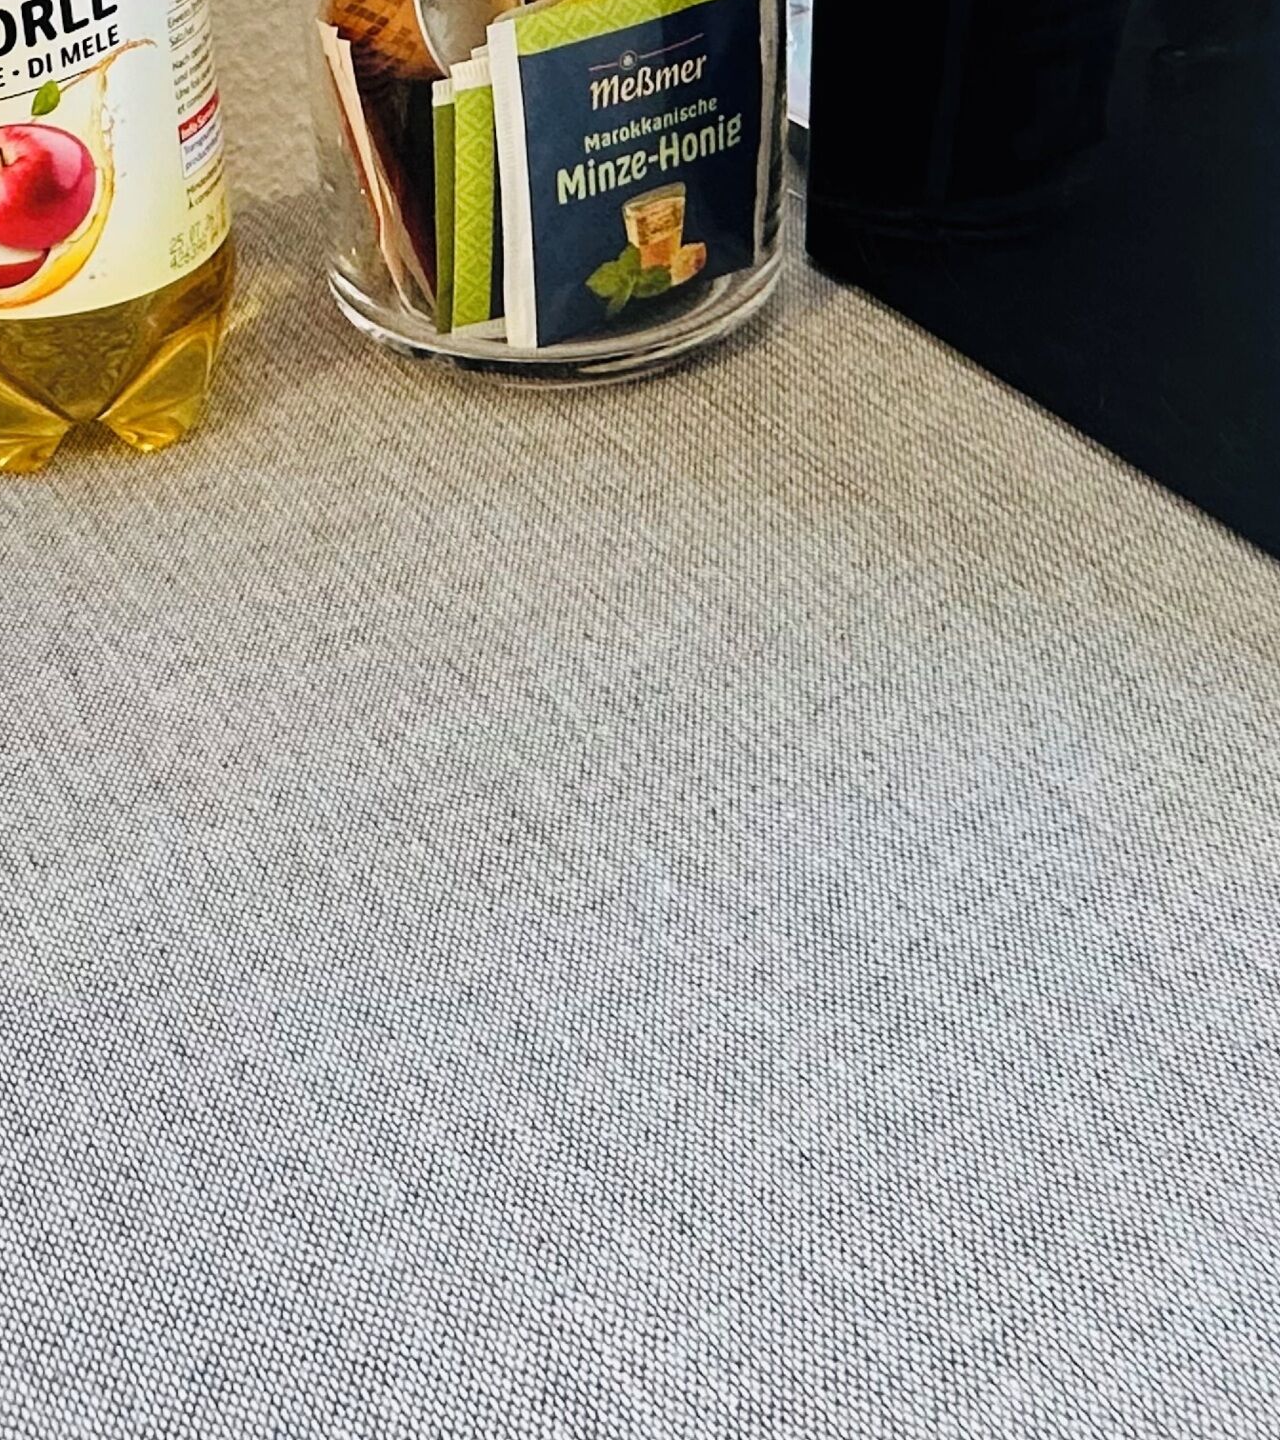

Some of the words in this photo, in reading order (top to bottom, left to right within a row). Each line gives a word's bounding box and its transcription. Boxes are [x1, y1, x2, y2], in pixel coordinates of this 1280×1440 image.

[27, 53, 54, 81] DI
[60, 23, 120, 70] MELE
[590, 54, 708, 111] Meßmer
[583, 95, 719, 154] Marokkanische
[555, 111, 744, 206] Minze-Honig
